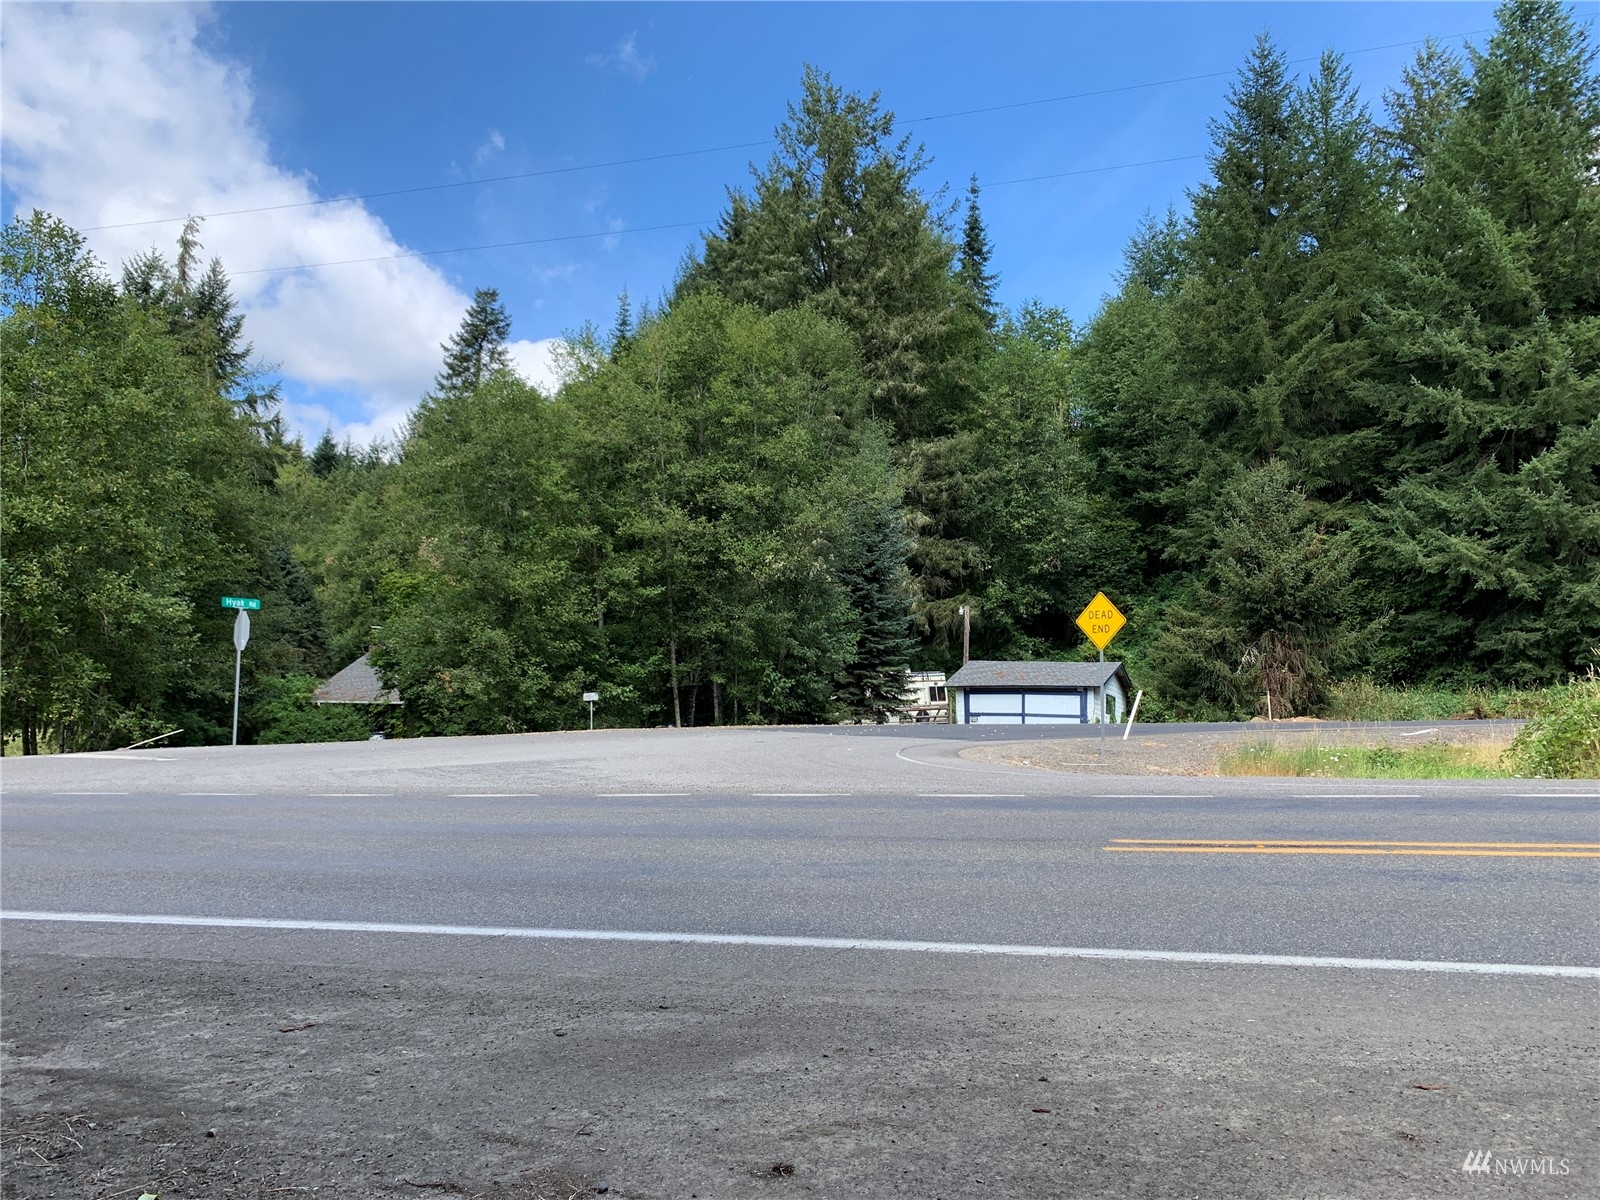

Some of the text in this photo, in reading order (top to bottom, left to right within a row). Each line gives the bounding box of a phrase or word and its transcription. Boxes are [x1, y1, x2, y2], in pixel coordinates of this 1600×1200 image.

[226, 598, 245, 607] Hyak
[1088, 610, 1113, 620] DEAD
[1092, 624, 1110, 634] END
